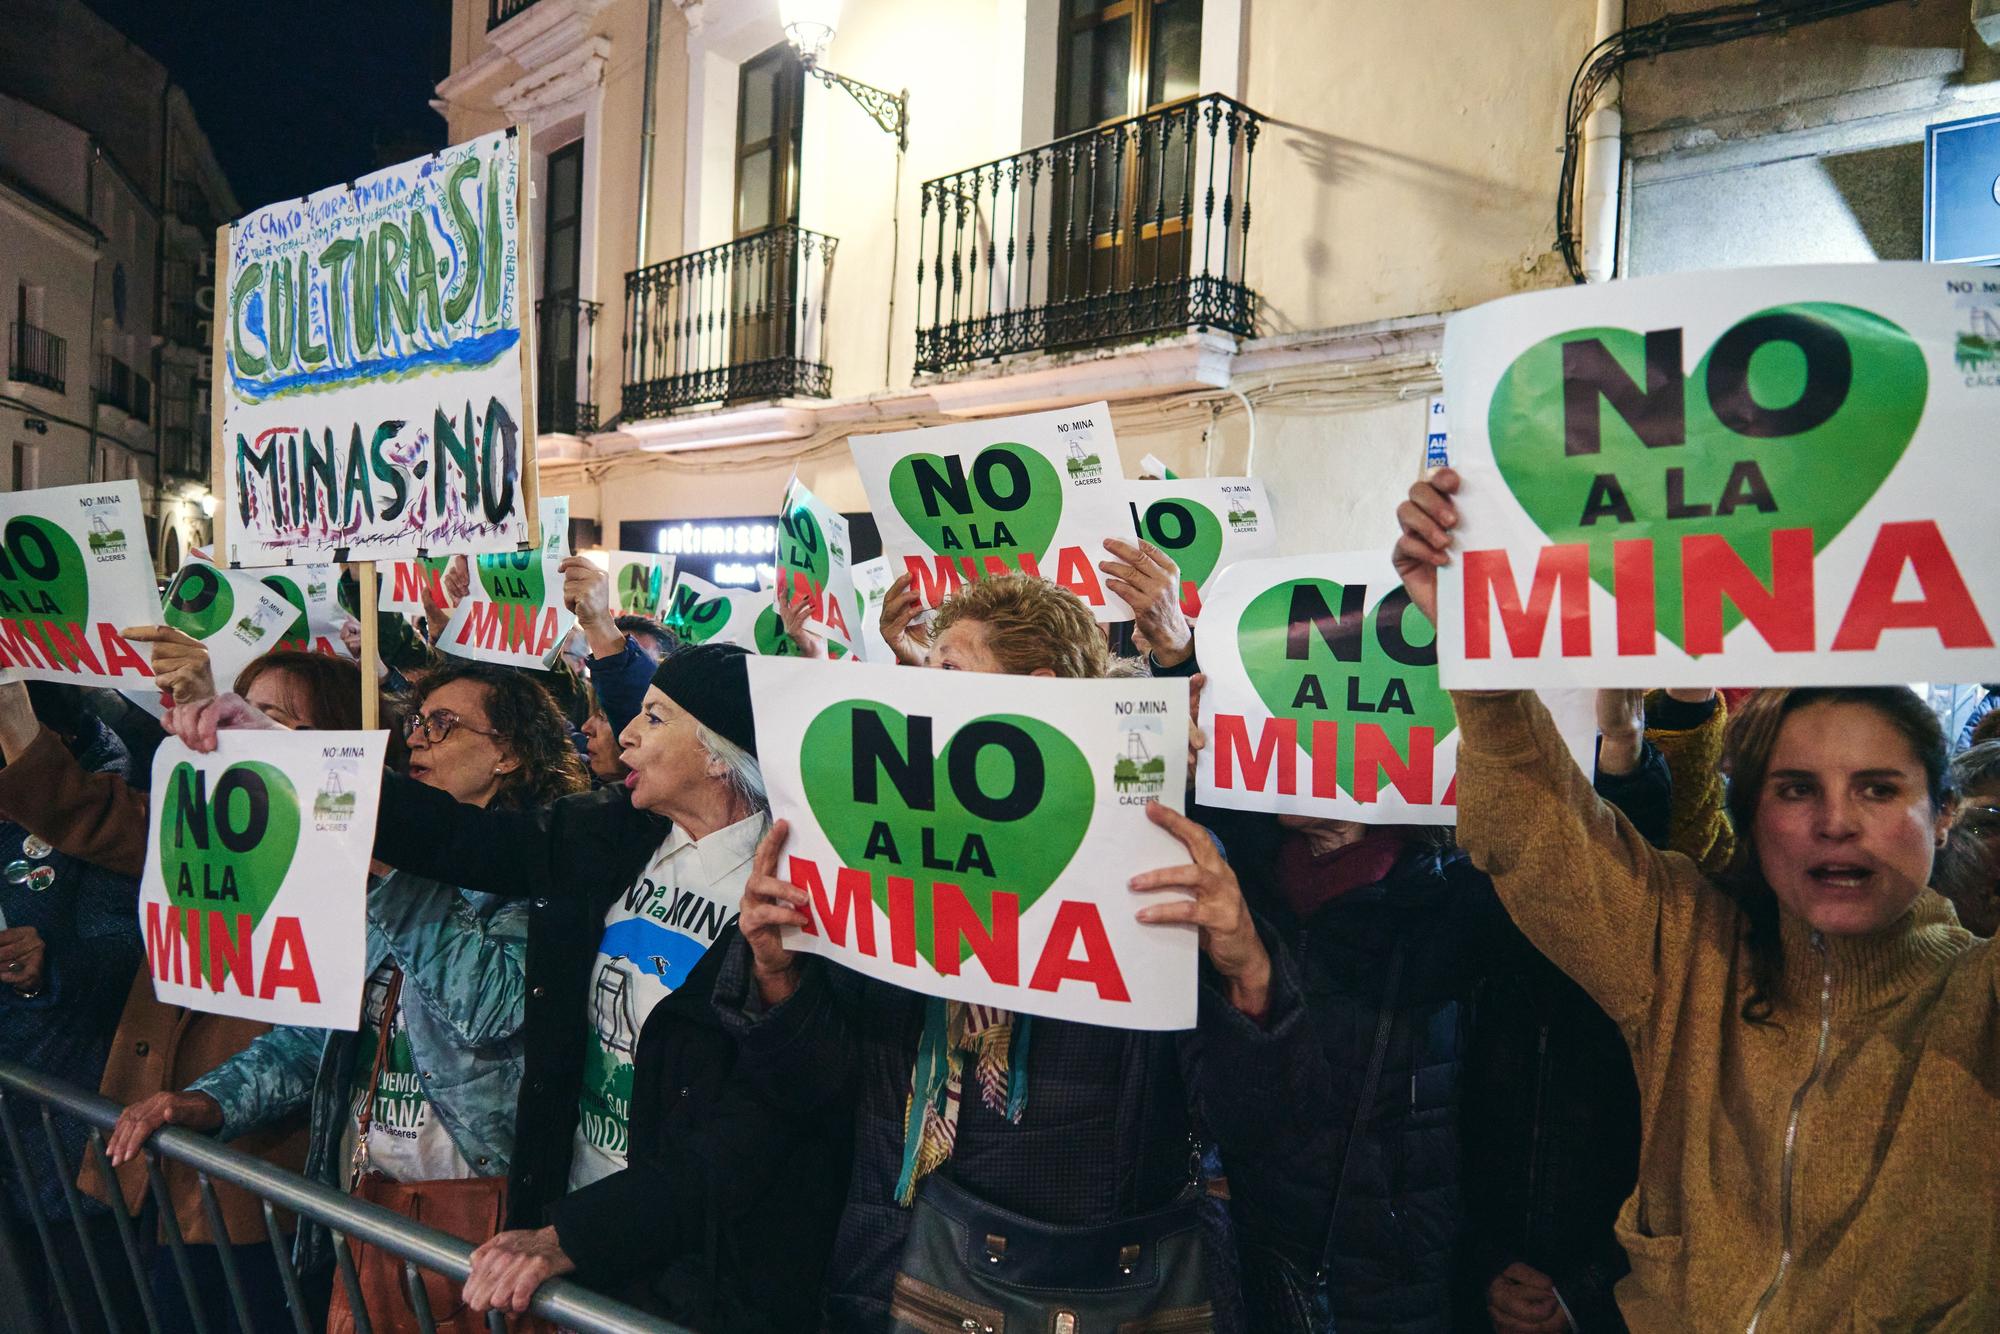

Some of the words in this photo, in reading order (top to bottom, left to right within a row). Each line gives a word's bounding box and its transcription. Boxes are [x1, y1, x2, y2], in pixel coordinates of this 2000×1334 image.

[260, 211, 302, 239] CANTO
[233, 211, 441, 377] CULTURA
[1946, 281, 1973, 293] NO
[1562, 313, 1852, 456] NO
[1057, 423, 1069, 433] NO
[1072, 419, 1094, 431] MINA
[236, 420, 406, 528] MINAS
[434, 396, 518, 523] NO
[911, 448, 1031, 517] NO
[80, 497, 93, 507] NO
[97, 495, 121, 505] MINA
[1579, 474, 1635, 526] A
[1666, 460, 1779, 520] LA
[659, 522, 775, 554] intimissi
[942, 525, 963, 550] A
[971, 521, 1018, 550] LA
[18, 589, 64, 615] LA
[494, 576, 506, 597] A
[506, 577, 531, 599] LA
[1463, 519, 1995, 659] MINA
[455, 601, 559, 656] MINA
[1285, 583, 1438, 666] NO
[1115, 701, 1133, 715] NO
[1139, 701, 1168, 714] MINA
[1291, 674, 1328, 710] A
[1347, 676, 1415, 715] LA
[322, 747, 337, 758] NO
[340, 747, 365, 758] MINA
[851, 708, 1045, 823] NO
[174, 768, 270, 853] NO
[863, 821, 901, 865] A
[921, 827, 997, 878] LA
[177, 862, 194, 898] A
[203, 863, 240, 902] LA
[646, 900, 666, 919] la
[789, 854, 1131, 1003] MINA
[146, 902, 321, 1004] MINA
[607, 1093, 629, 1121] SAL
